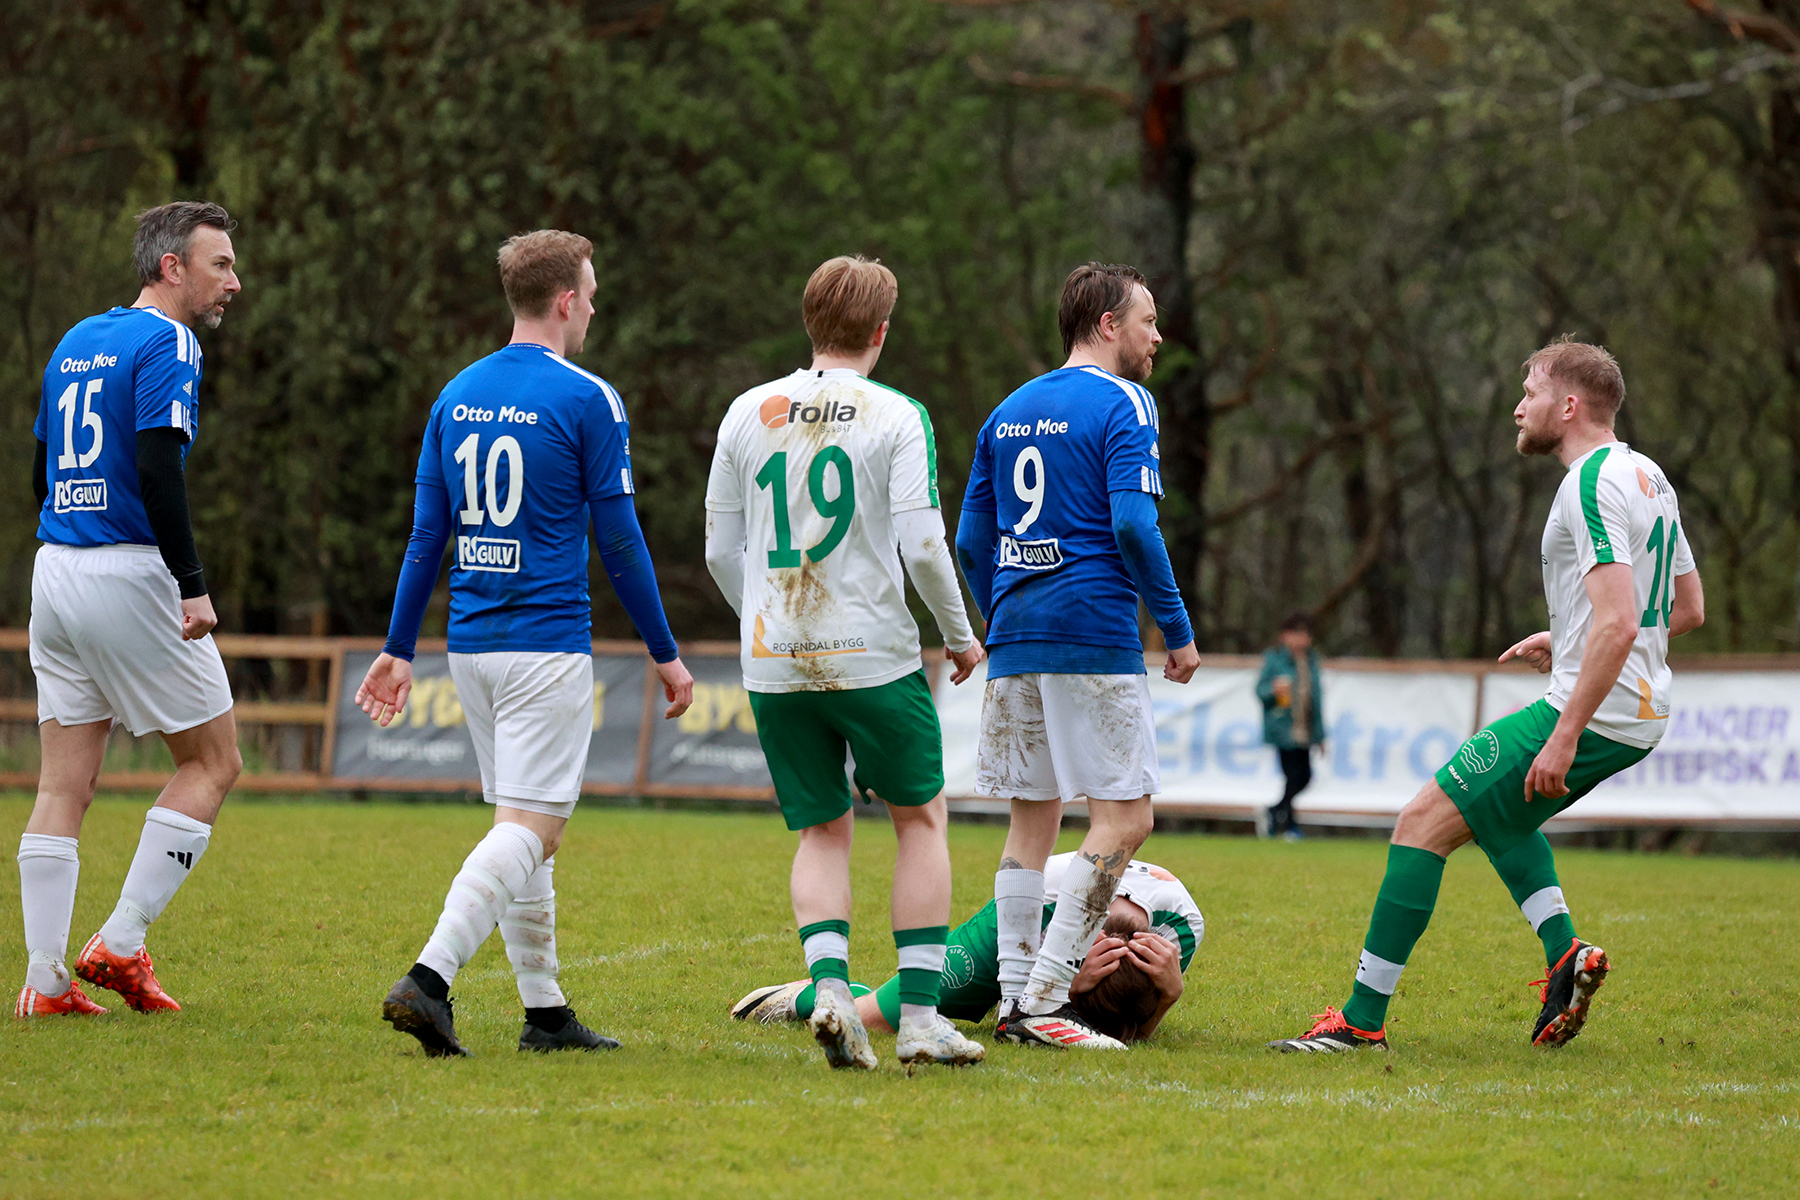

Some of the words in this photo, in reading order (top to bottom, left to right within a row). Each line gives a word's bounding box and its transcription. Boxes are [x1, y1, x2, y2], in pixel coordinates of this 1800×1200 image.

[60, 357, 90, 374] Otto
[91, 353, 117, 370] Moe
[452, 404, 494, 422] Otto
[498, 406, 538, 425] Moe
[788, 401, 857, 423] folla
[58, 378, 104, 470] 15
[996, 422, 1031, 439] Otto
[1035, 418, 1069, 436] Moe
[454, 433, 524, 527] 10
[1013, 446, 1045, 535] 9
[755, 445, 855, 569] 19
[772, 641, 831, 653] ROSENDAL
[834, 637, 864, 649] BYGG
[1448, 765, 1464, 784] CRAFT
